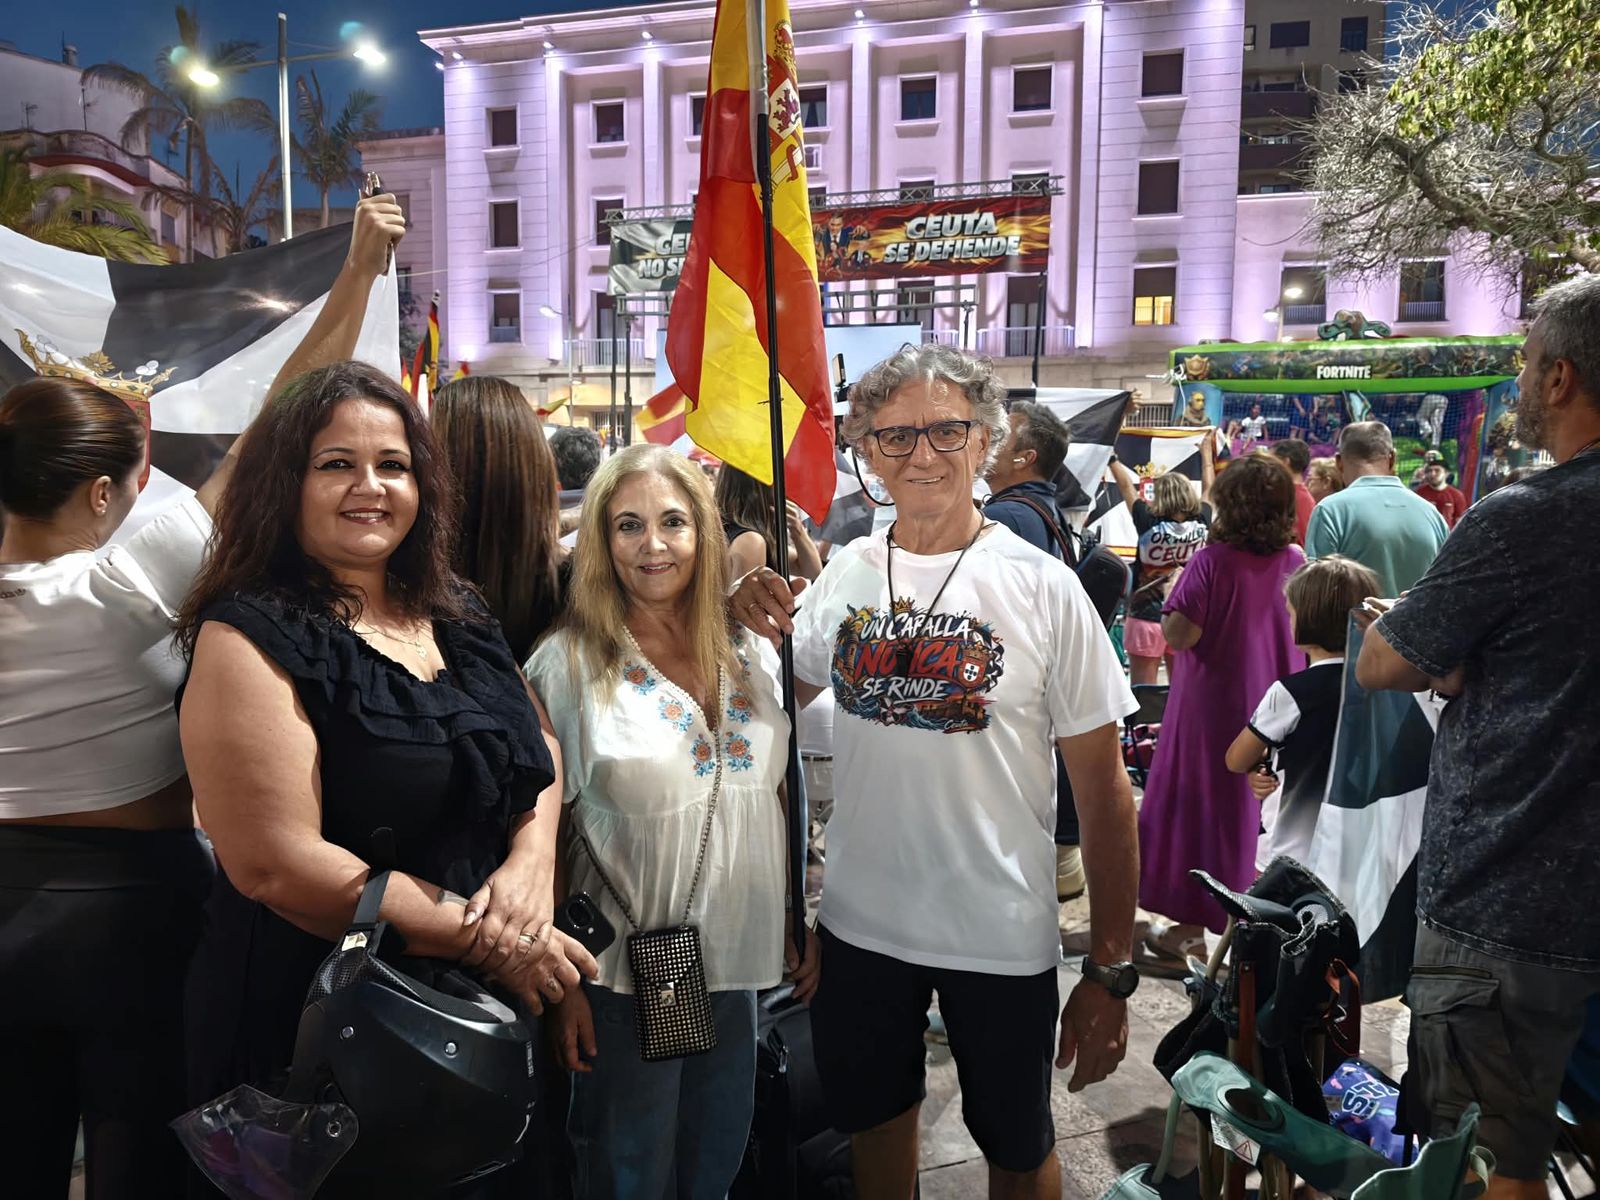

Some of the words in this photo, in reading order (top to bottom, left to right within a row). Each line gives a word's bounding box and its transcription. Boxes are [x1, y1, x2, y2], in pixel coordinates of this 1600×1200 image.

[906, 212, 997, 239] CEUTA
[655, 232, 691, 255] CE
[884, 242, 911, 263] SE
[914, 235, 1020, 261] DEFIENDE
[639, 258, 664, 278] NO
[1316, 365, 1371, 379] FORTNITE
[860, 617, 887, 640] UN
[860, 677, 887, 699] SE
